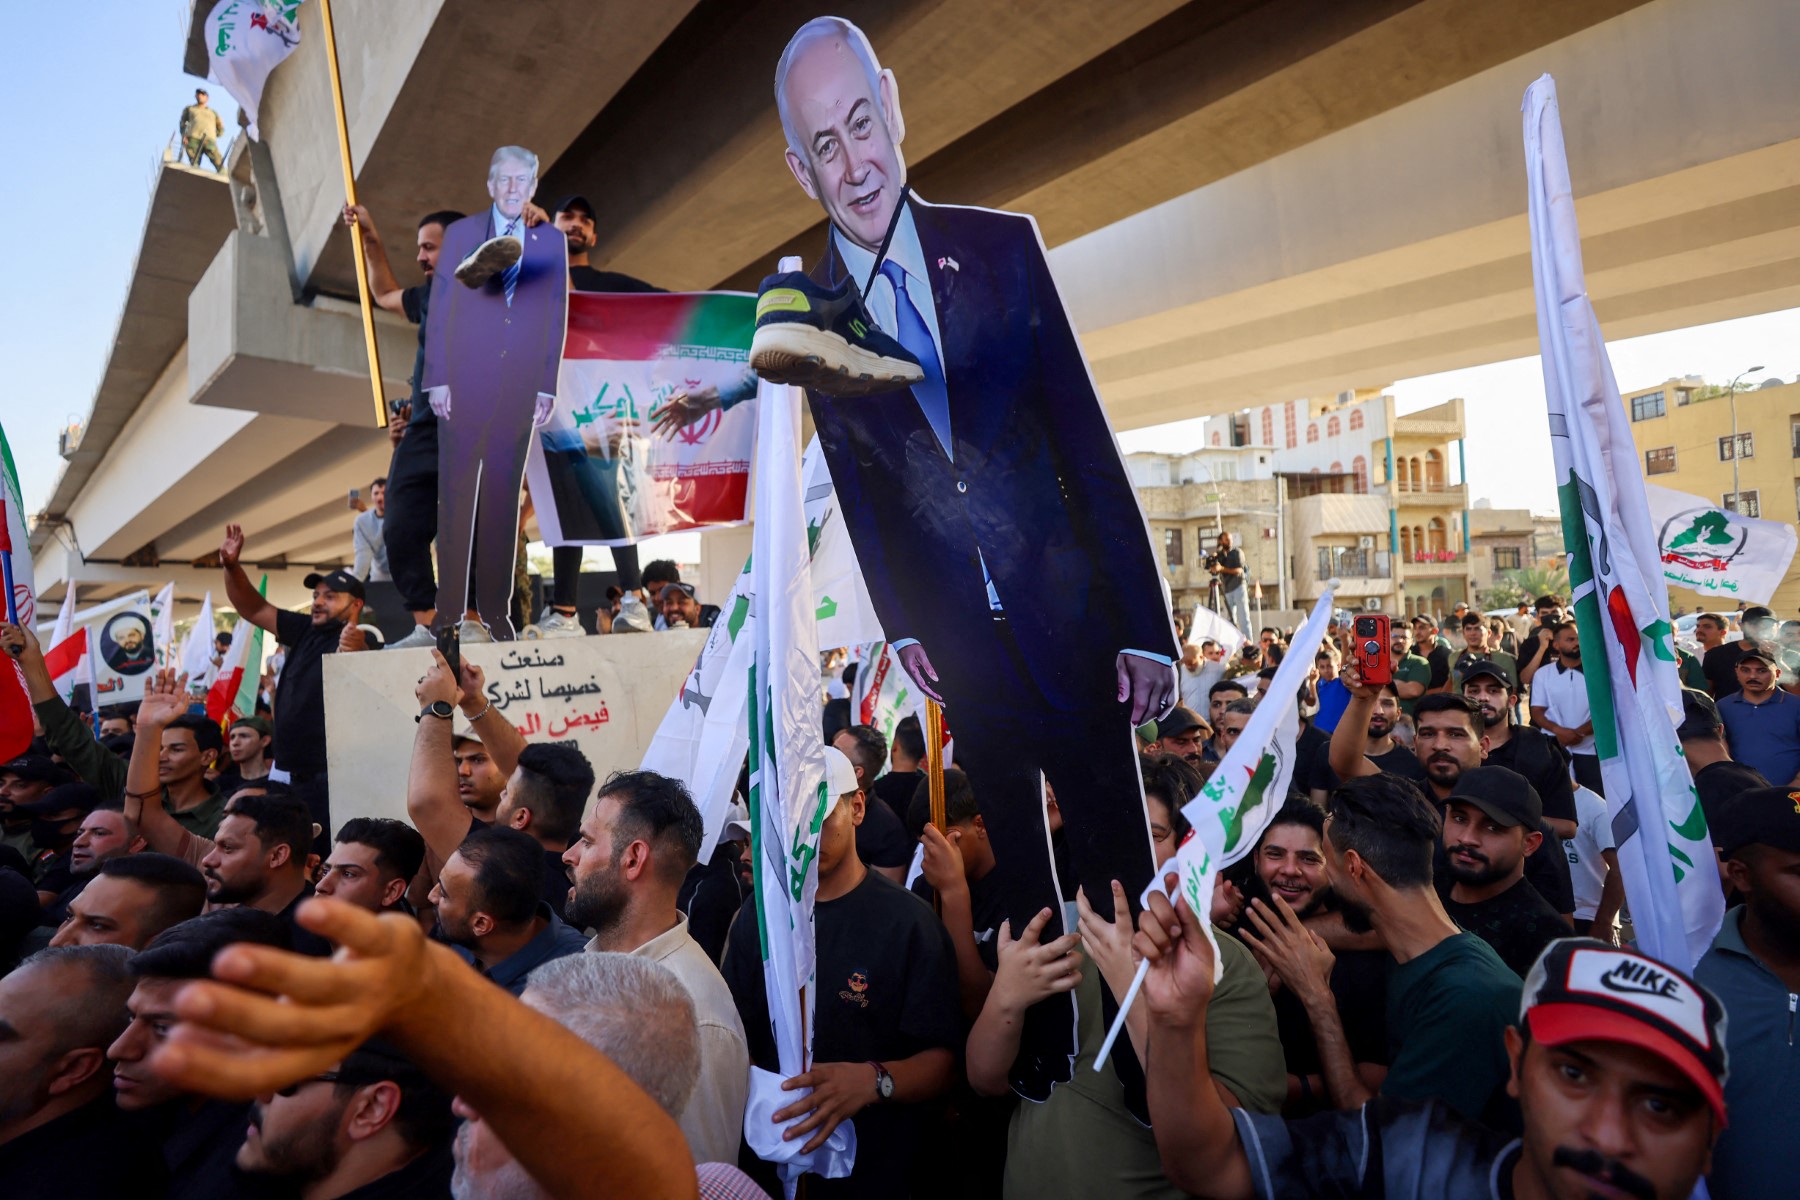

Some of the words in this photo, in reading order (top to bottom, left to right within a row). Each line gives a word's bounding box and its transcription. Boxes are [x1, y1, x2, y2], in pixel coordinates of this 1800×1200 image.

[501, 648, 565, 671] صنعت
[487, 678, 532, 710] لشرك
[539, 674, 602, 703] خصيصا
[548, 700, 610, 738] فيض
[1613, 959, 1681, 996] NIKE
